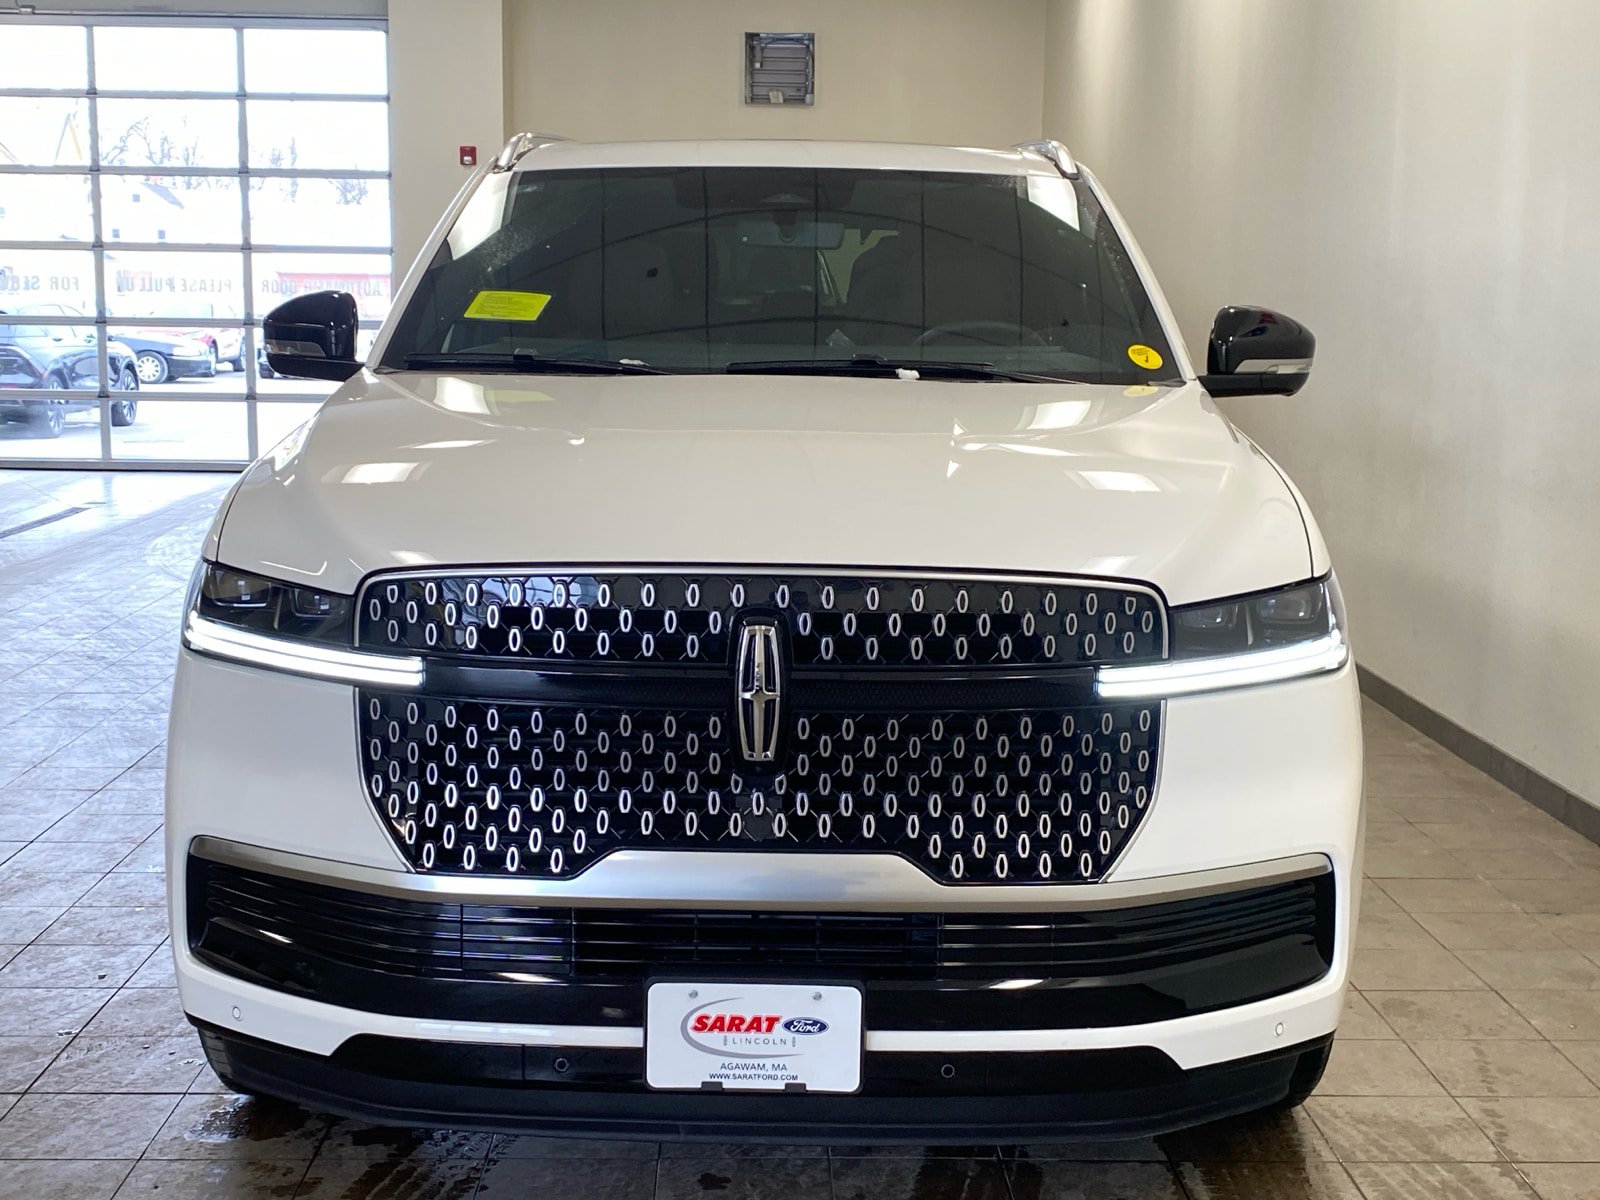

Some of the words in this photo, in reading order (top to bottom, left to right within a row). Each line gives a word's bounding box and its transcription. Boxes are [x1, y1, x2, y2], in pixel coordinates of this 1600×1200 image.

[691, 1014, 782, 1034] SARAT
[789, 1019, 820, 1032] Ford
[732, 1037, 787, 1045] LINCOLN
[720, 1062, 769, 1072] AGAWAM,
[771, 1063, 788, 1072] MA
[709, 1072, 798, 1081] WWW.SARATFORD.COM
